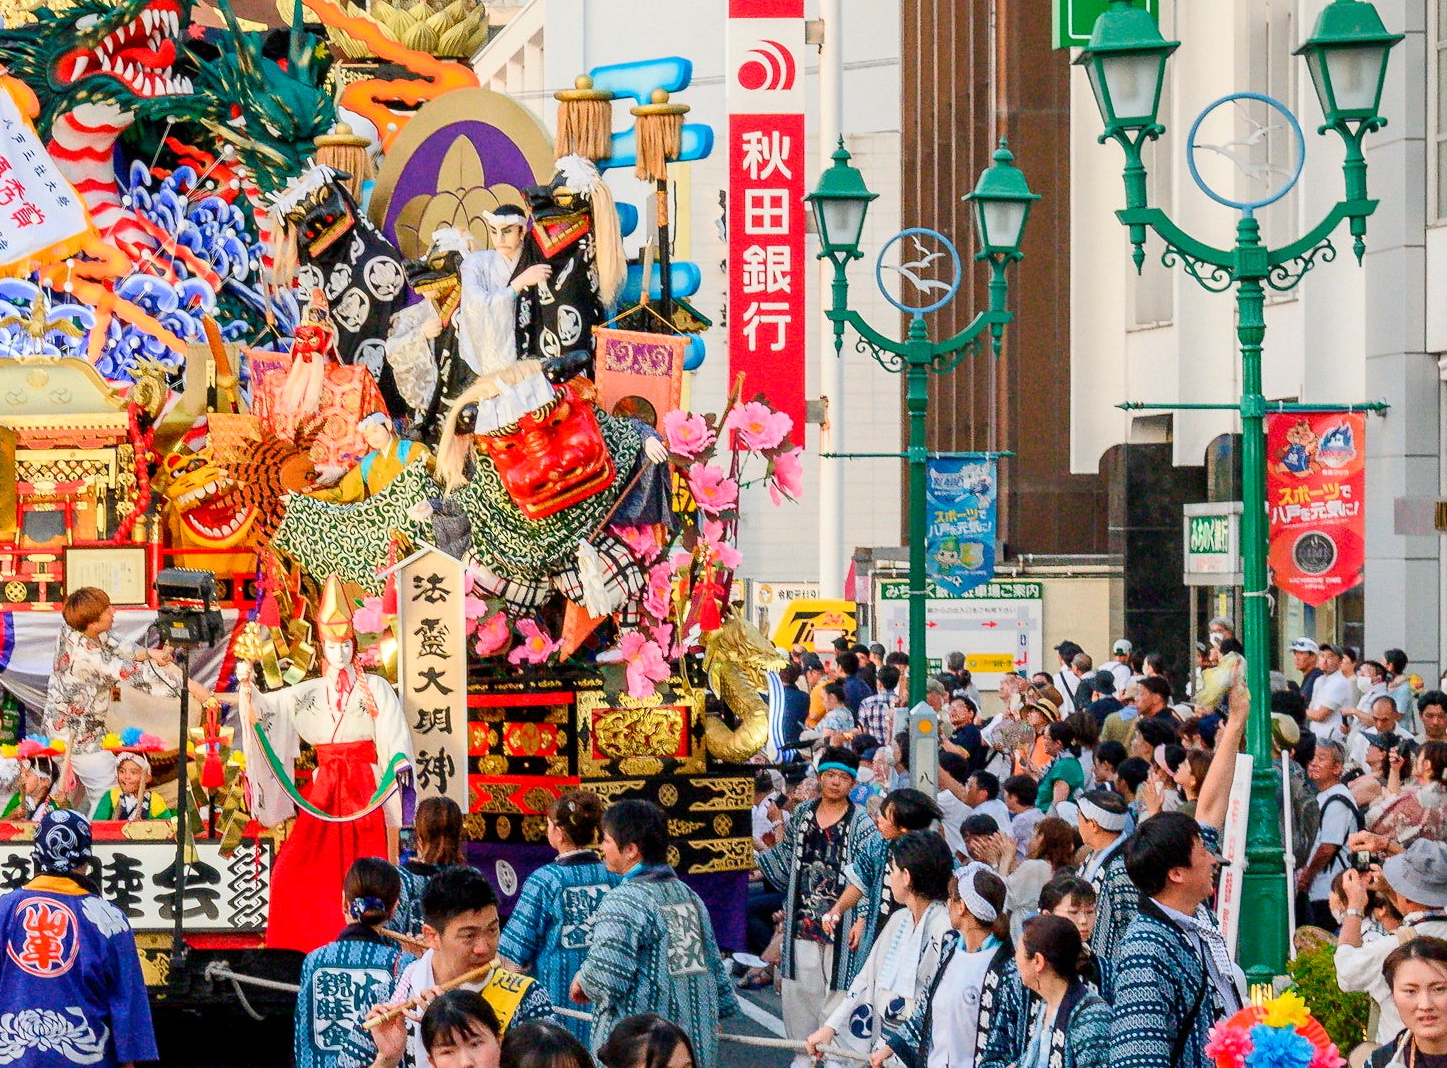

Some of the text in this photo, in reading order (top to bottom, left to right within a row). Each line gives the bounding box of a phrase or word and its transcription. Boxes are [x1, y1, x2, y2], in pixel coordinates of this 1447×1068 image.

[741, 130, 792, 353] 秋田銀行
[1278, 482, 1352, 505] スポーツで
[885, 583, 1040, 599] みちく銀車場ご案内
